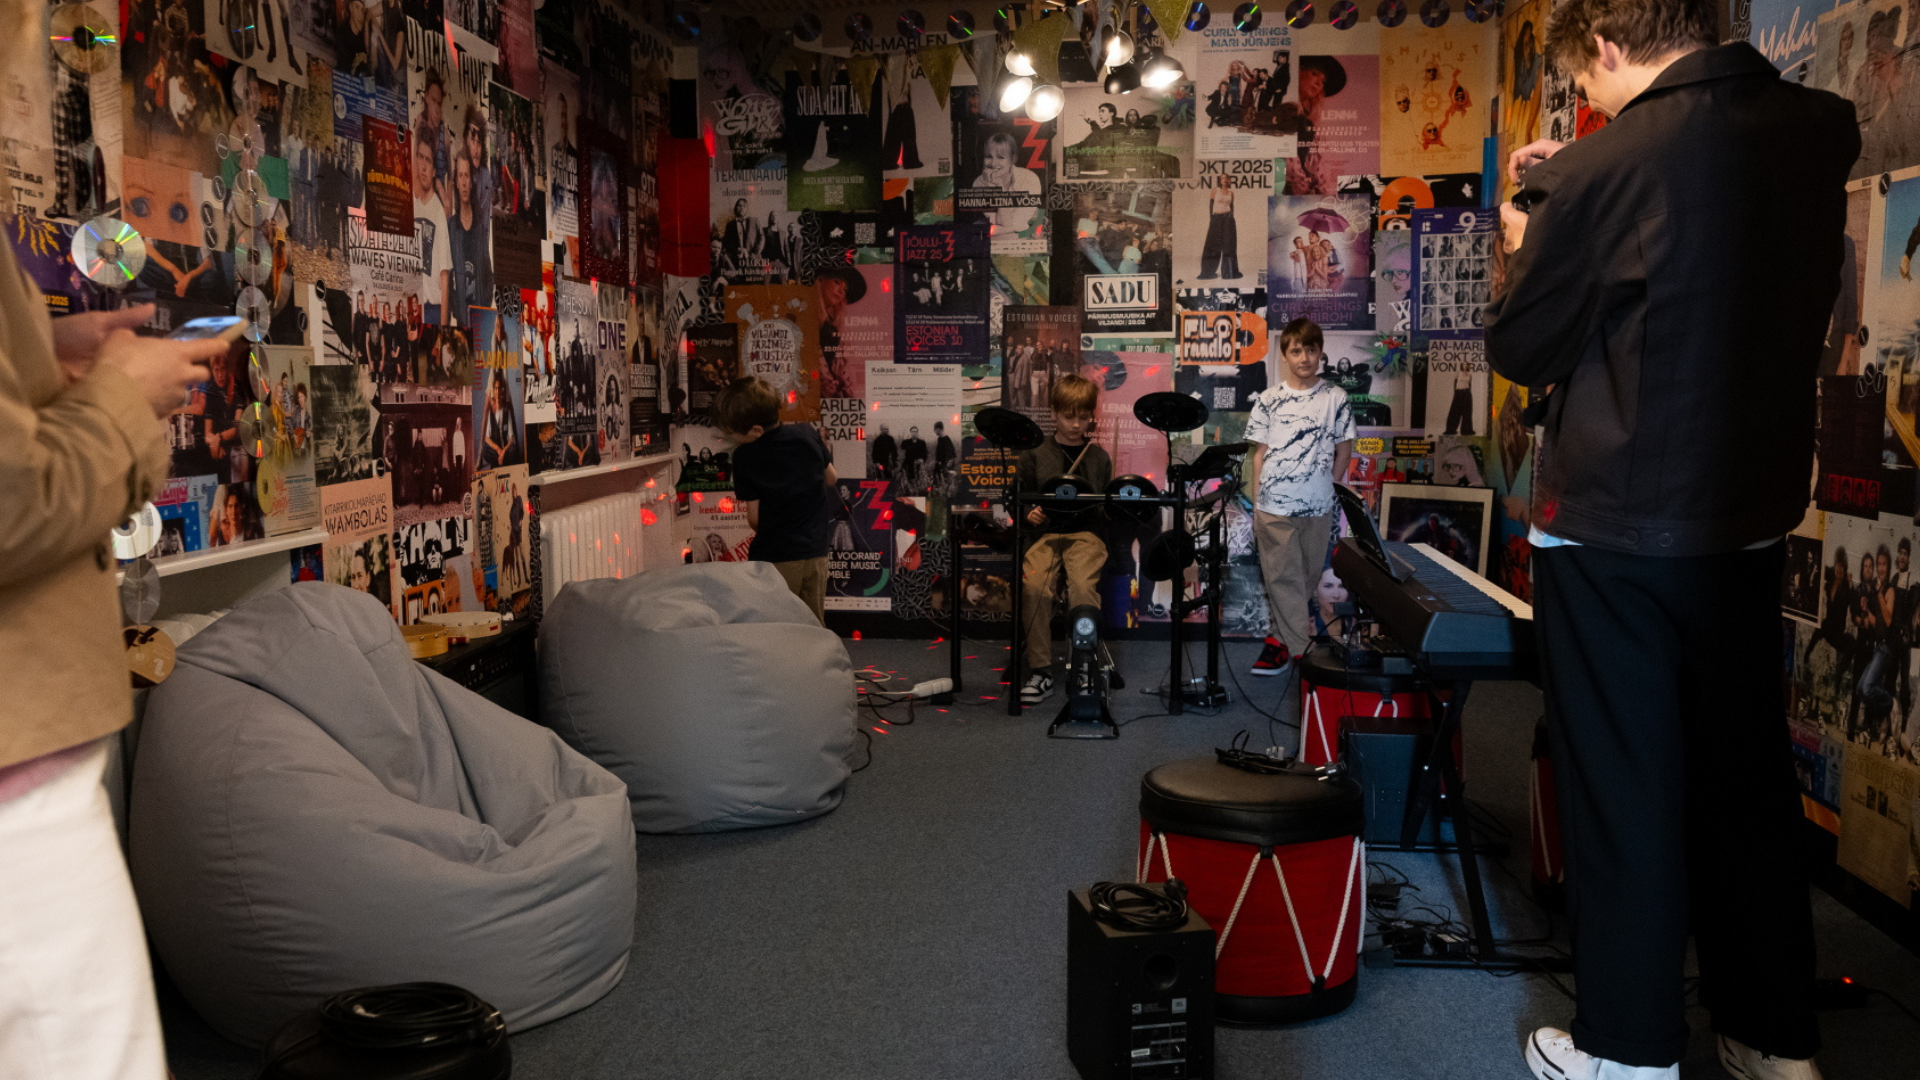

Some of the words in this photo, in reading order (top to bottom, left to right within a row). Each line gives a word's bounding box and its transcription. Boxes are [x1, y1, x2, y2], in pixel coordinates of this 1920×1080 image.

[1211, 39, 1239, 48] MARI
[1242, 36, 1292, 47] JÜRJENS
[1232, 160, 1273, 174] 2025
[958, 197, 1014, 207] HANNA-LIINA
[1016, 195, 1042, 206] VÕSA
[907, 249, 926, 260] JAZZ
[930, 249, 943, 260] 25
[350, 248, 384, 269] WAVES
[387, 254, 421, 276] VIENNA
[1091, 281, 1151, 304] SADU
[1271, 303, 1310, 313] CURLY
[1312, 301, 1364, 312] STRINGS
[1007, 313, 1047, 322] ESTONIAN
[1049, 314, 1078, 323] VOICES
[1281, 313, 1289, 322] &
[597, 320, 626, 350] ONE
[751, 330, 789, 339] VILJANDI
[906, 325, 959, 335] ESTONIAN
[906, 335, 947, 346] VOICES
[1444, 352, 1468, 362] OKT
[1431, 362, 1457, 372] VON
[324, 505, 388, 536] WAMBOLAS
[837, 552, 881, 562] VOORAND
[850, 561, 881, 571] MUSIC
